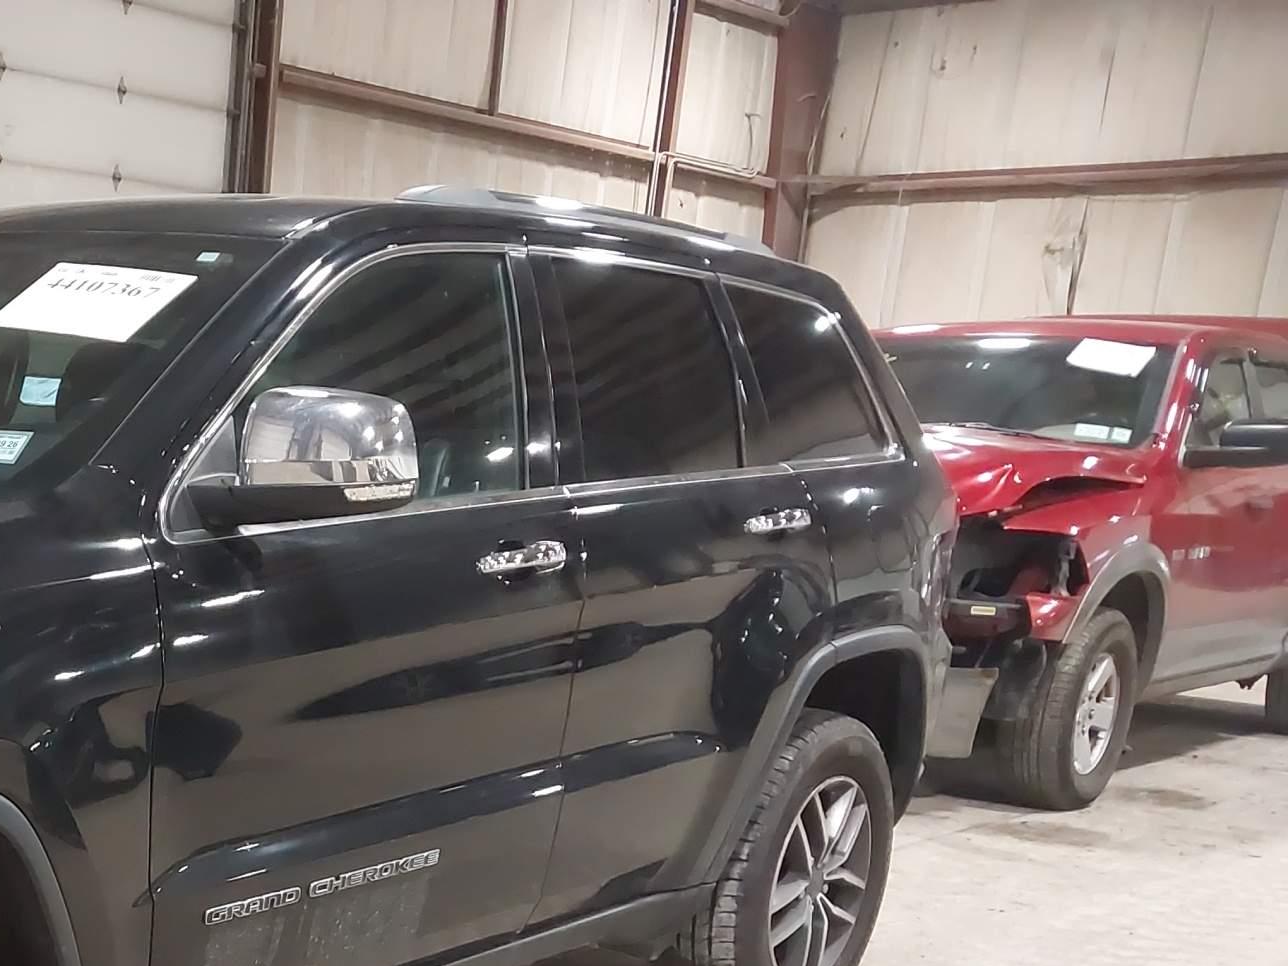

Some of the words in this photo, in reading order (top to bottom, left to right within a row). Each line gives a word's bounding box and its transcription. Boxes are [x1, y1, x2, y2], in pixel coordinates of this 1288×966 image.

[47, 278, 162, 298] 44107367
[205, 887, 302, 925] GRAND
[309, 849, 441, 897] CHEROKEE
